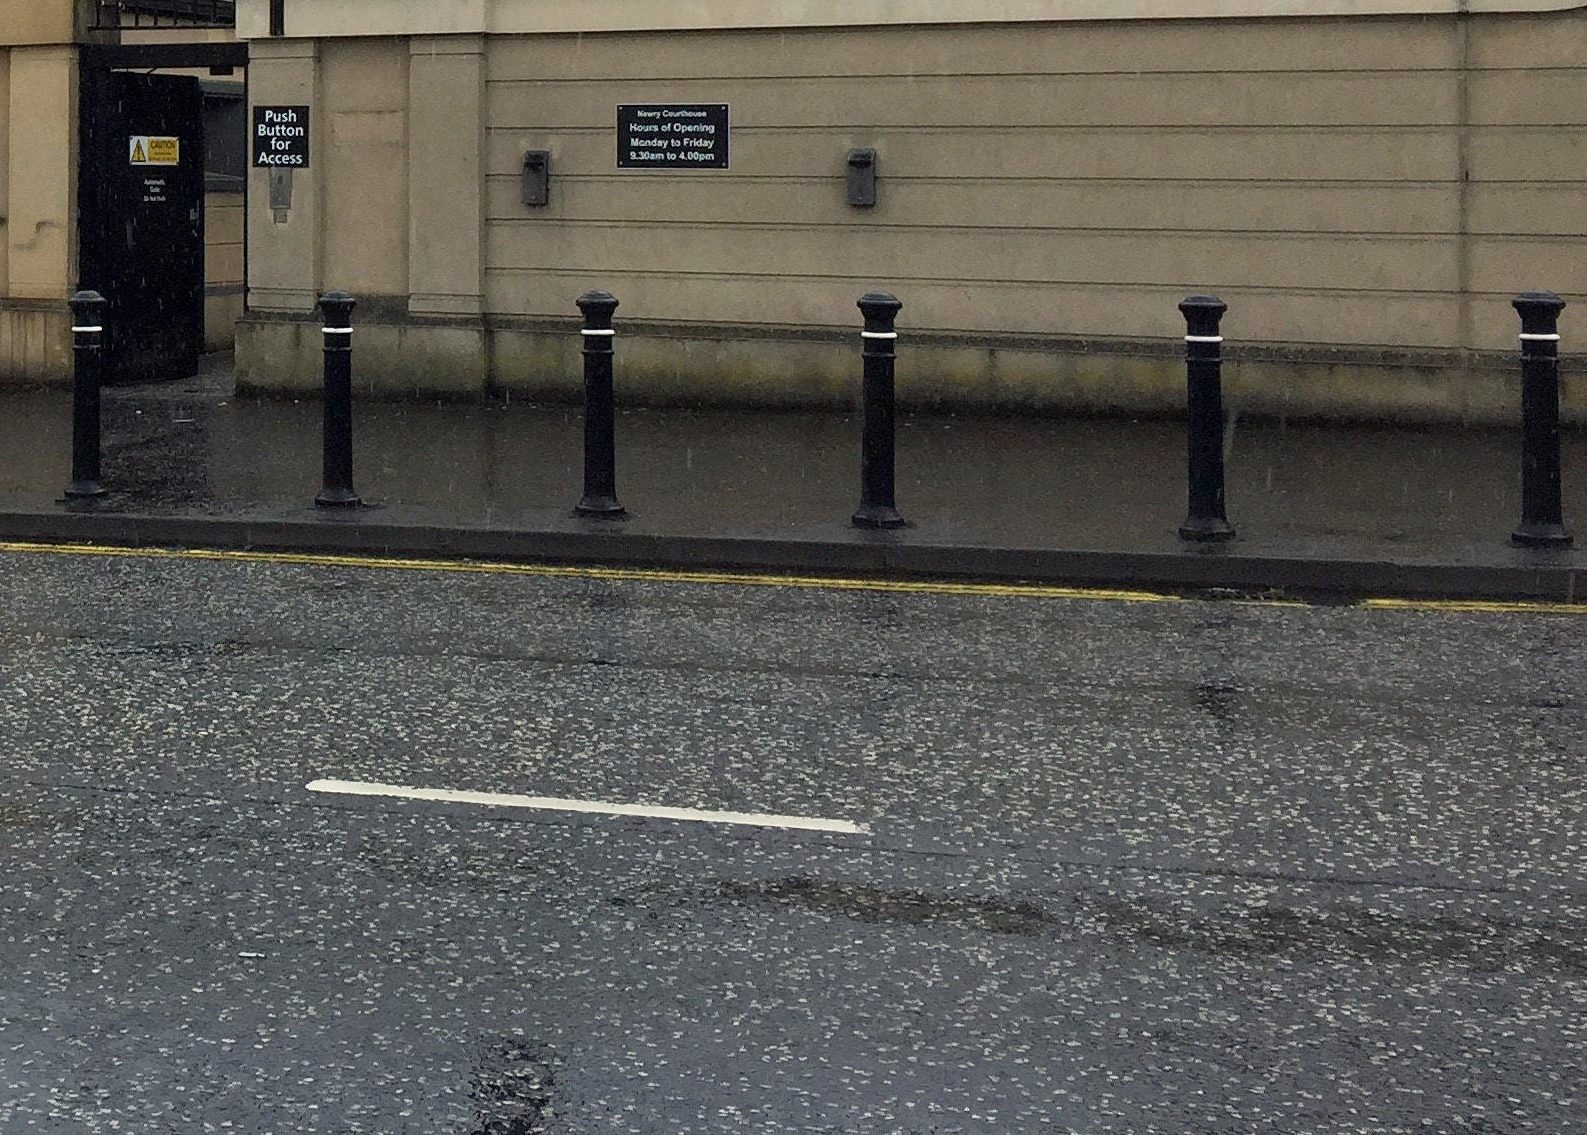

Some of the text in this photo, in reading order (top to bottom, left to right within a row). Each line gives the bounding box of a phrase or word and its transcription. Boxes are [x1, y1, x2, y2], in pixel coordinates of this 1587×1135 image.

[265, 109, 297, 123] Push
[662, 110, 708, 118] Courthouse
[257, 124, 304, 137] Button
[629, 122, 715, 134] Hours of Opening
[270, 137, 292, 150] for
[630, 137, 715, 149] Monday to Friday
[257, 151, 303, 165] Access
[629, 151, 715, 162] 9.30am to 4.00pm
